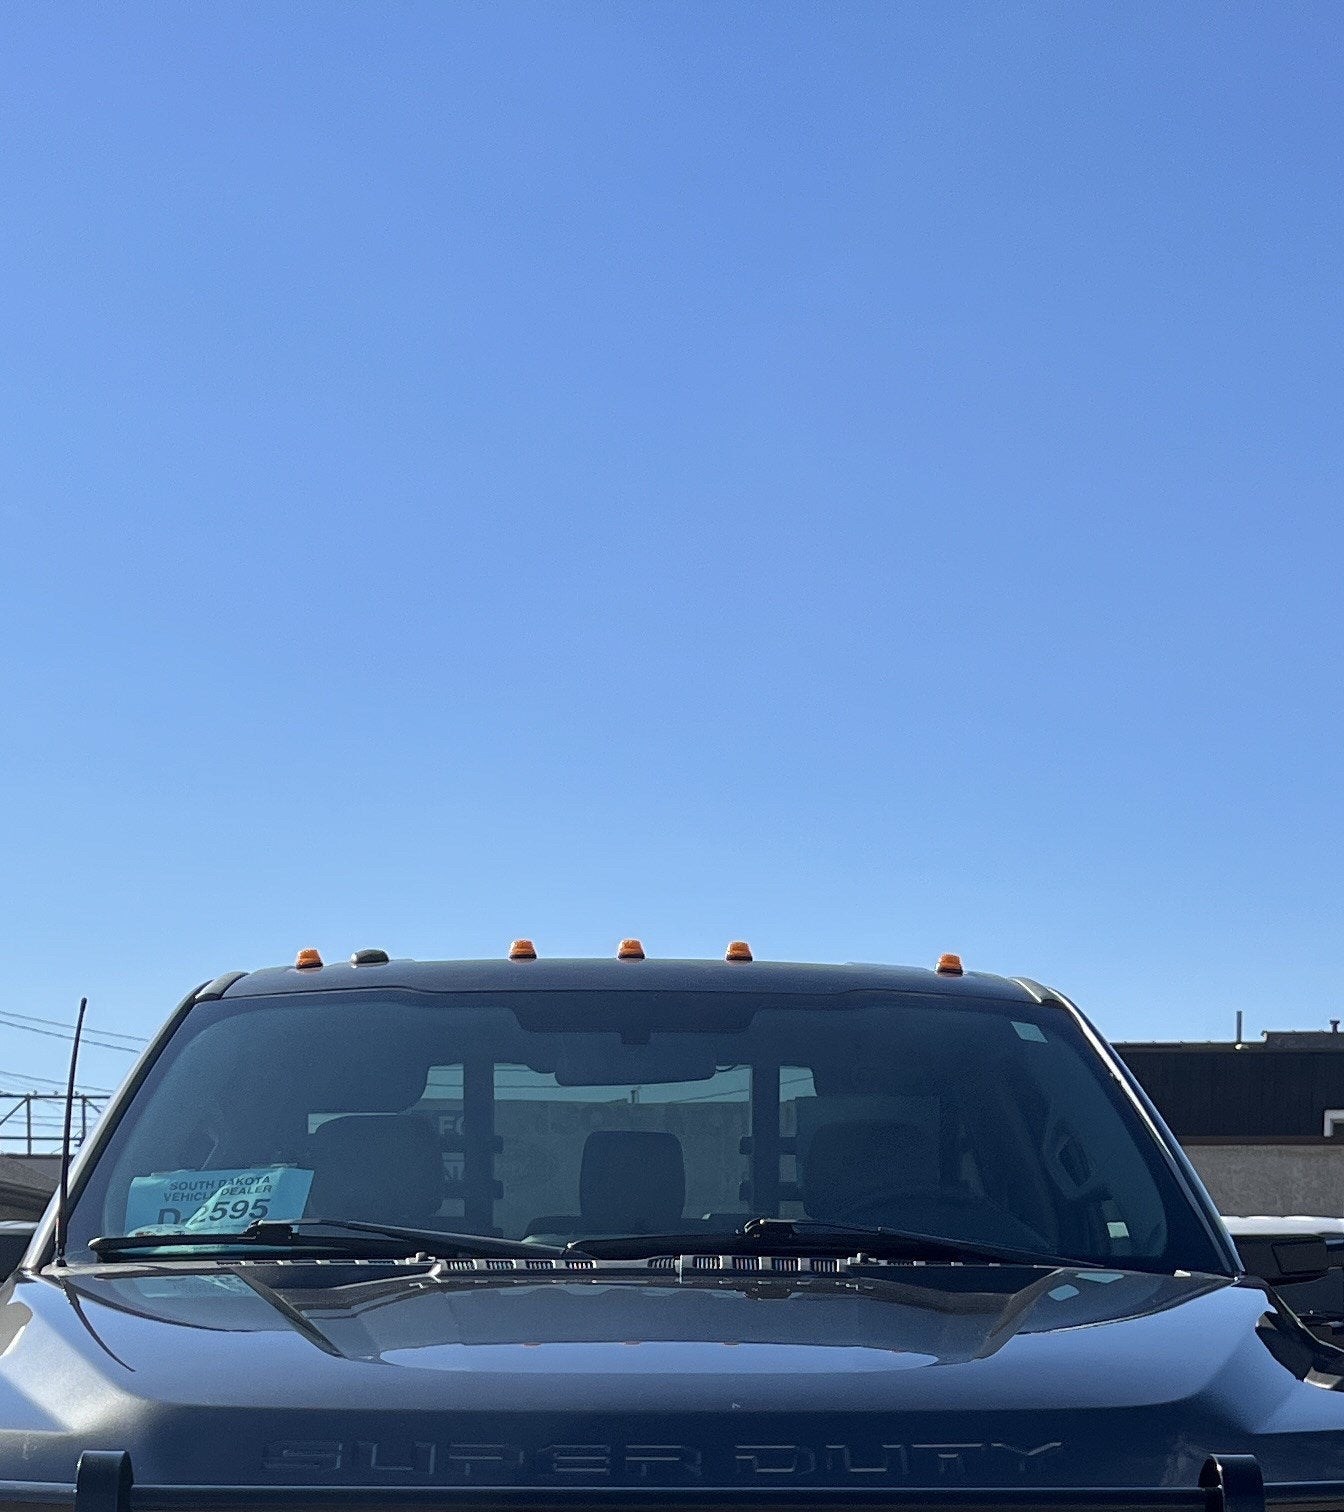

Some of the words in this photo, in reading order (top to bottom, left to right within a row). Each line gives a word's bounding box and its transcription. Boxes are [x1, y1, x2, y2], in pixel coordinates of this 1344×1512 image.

[168, 1180, 215, 1191] SOUTH
[218, 1175, 271, 1188] DAKOTA
[220, 1184, 273, 1196] DEALER
[261, 1440, 703, 1477] SUPER
[734, 1440, 1062, 1477] DUTY
